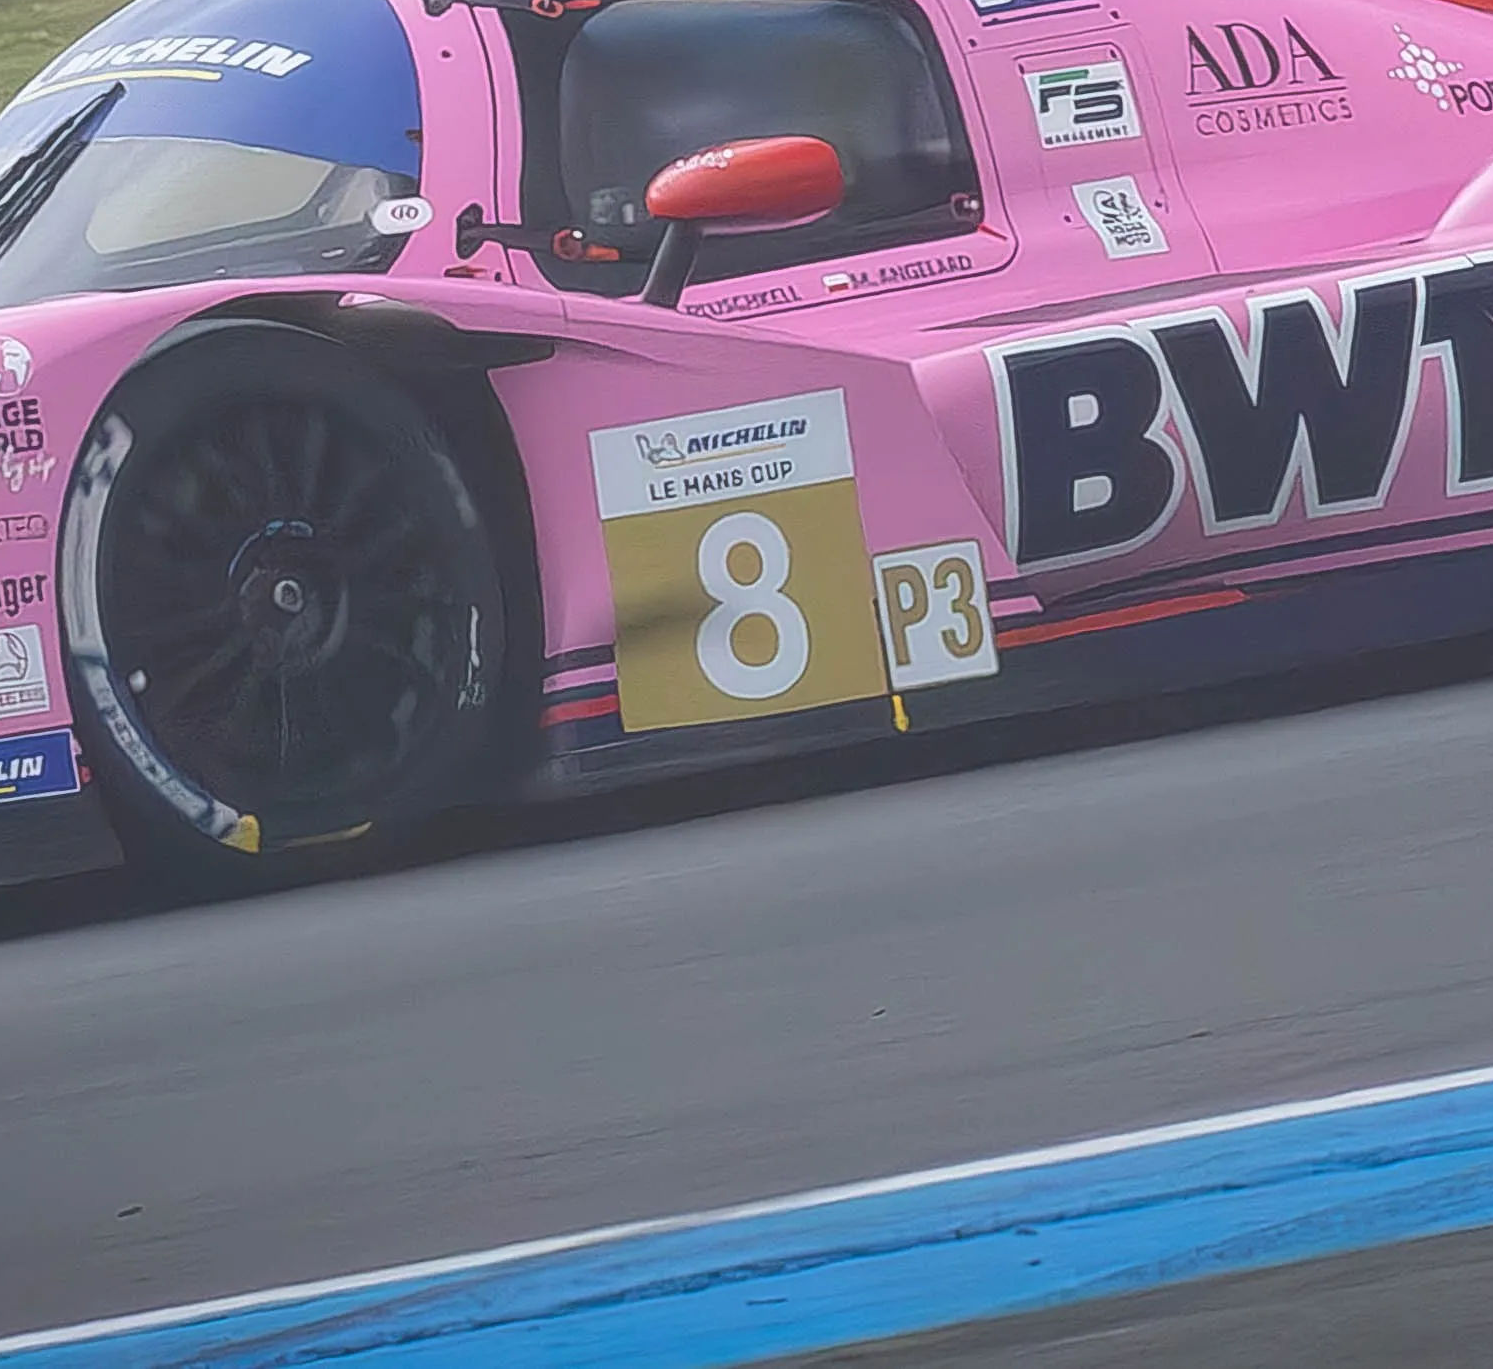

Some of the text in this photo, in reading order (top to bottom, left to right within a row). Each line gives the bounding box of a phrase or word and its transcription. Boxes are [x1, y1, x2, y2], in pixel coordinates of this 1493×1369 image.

[49, 37, 312, 78] MICHELIN
[1184, 17, 1347, 96] ADA
[1195, 96, 1354, 137] COSMETICS
[687, 419, 807, 455] MICHELIN
[649, 479, 678, 502] LE
[695, 511, 810, 700] 8
[881, 557, 984, 667] P3
